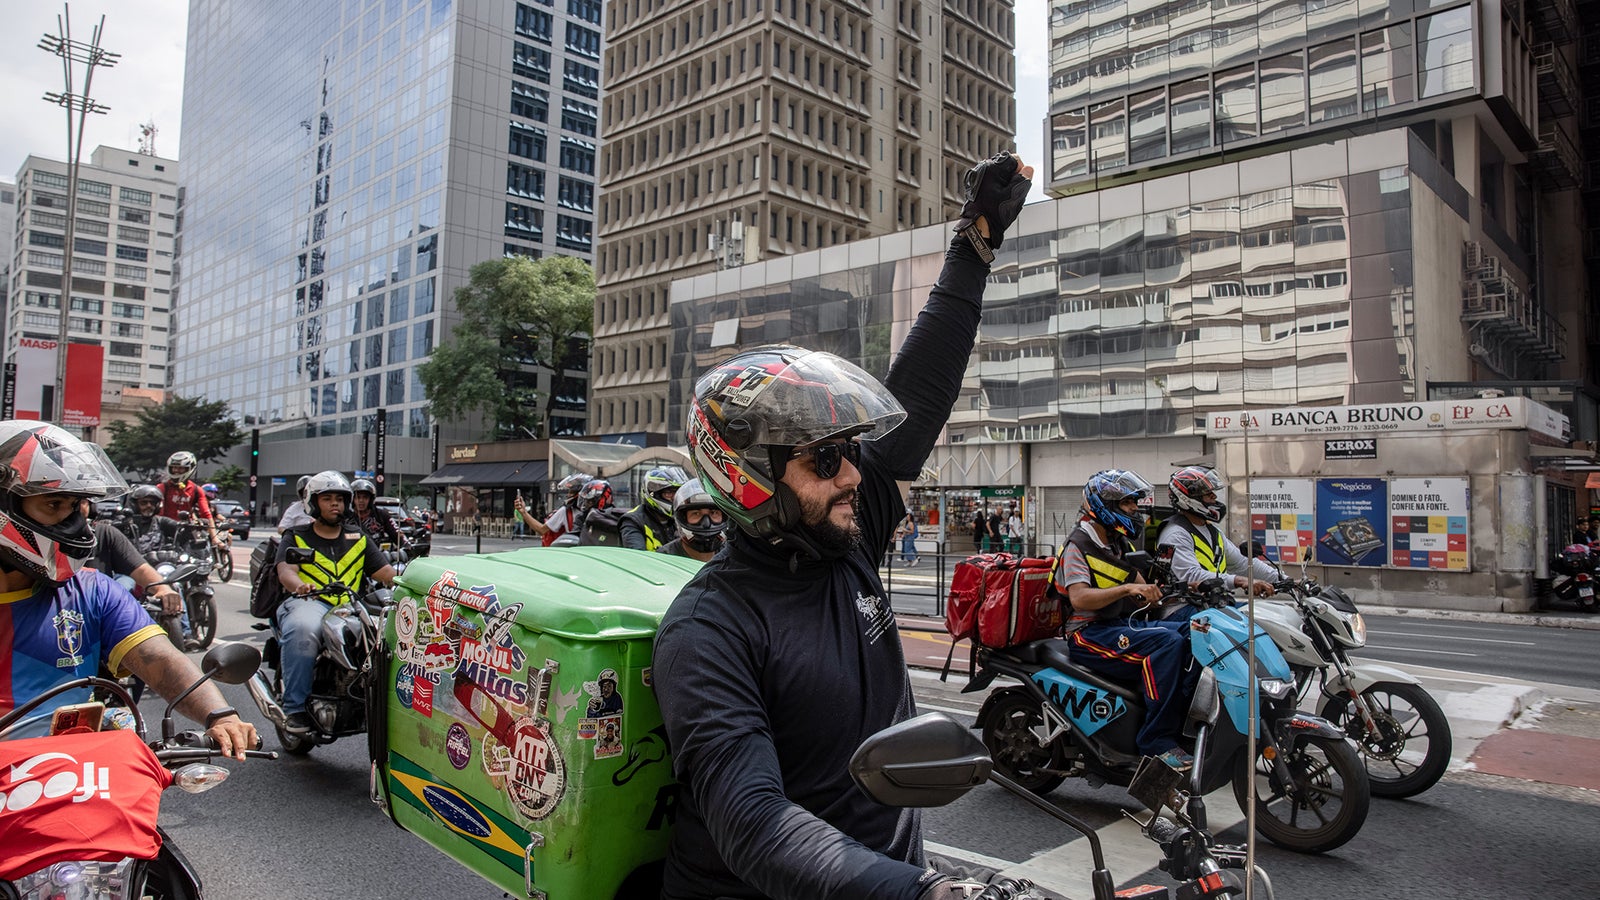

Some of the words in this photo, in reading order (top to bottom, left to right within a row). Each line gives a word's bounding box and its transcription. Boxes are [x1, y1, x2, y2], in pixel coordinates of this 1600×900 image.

[20, 338, 57, 350] MASP
[4, 381, 14, 403] Cintra
[1271, 410, 1338, 426] BANCA
[1347, 406, 1423, 423] BRUNO
[1326, 440, 1375, 451] XEROX
[1340, 482, 1372, 492] Negócios
[1391, 494, 1417, 502] DOMINE
[1426, 502, 1449, 510] FONTE.
[441, 586, 460, 599] SOU
[459, 591, 488, 610] MOTUL
[484, 608, 515, 643] NASA
[462, 641, 510, 670] MOTUL
[452, 658, 528, 706] Mitas
[514, 732, 548, 770] KTR
[0, 761, 111, 812] ifoo
